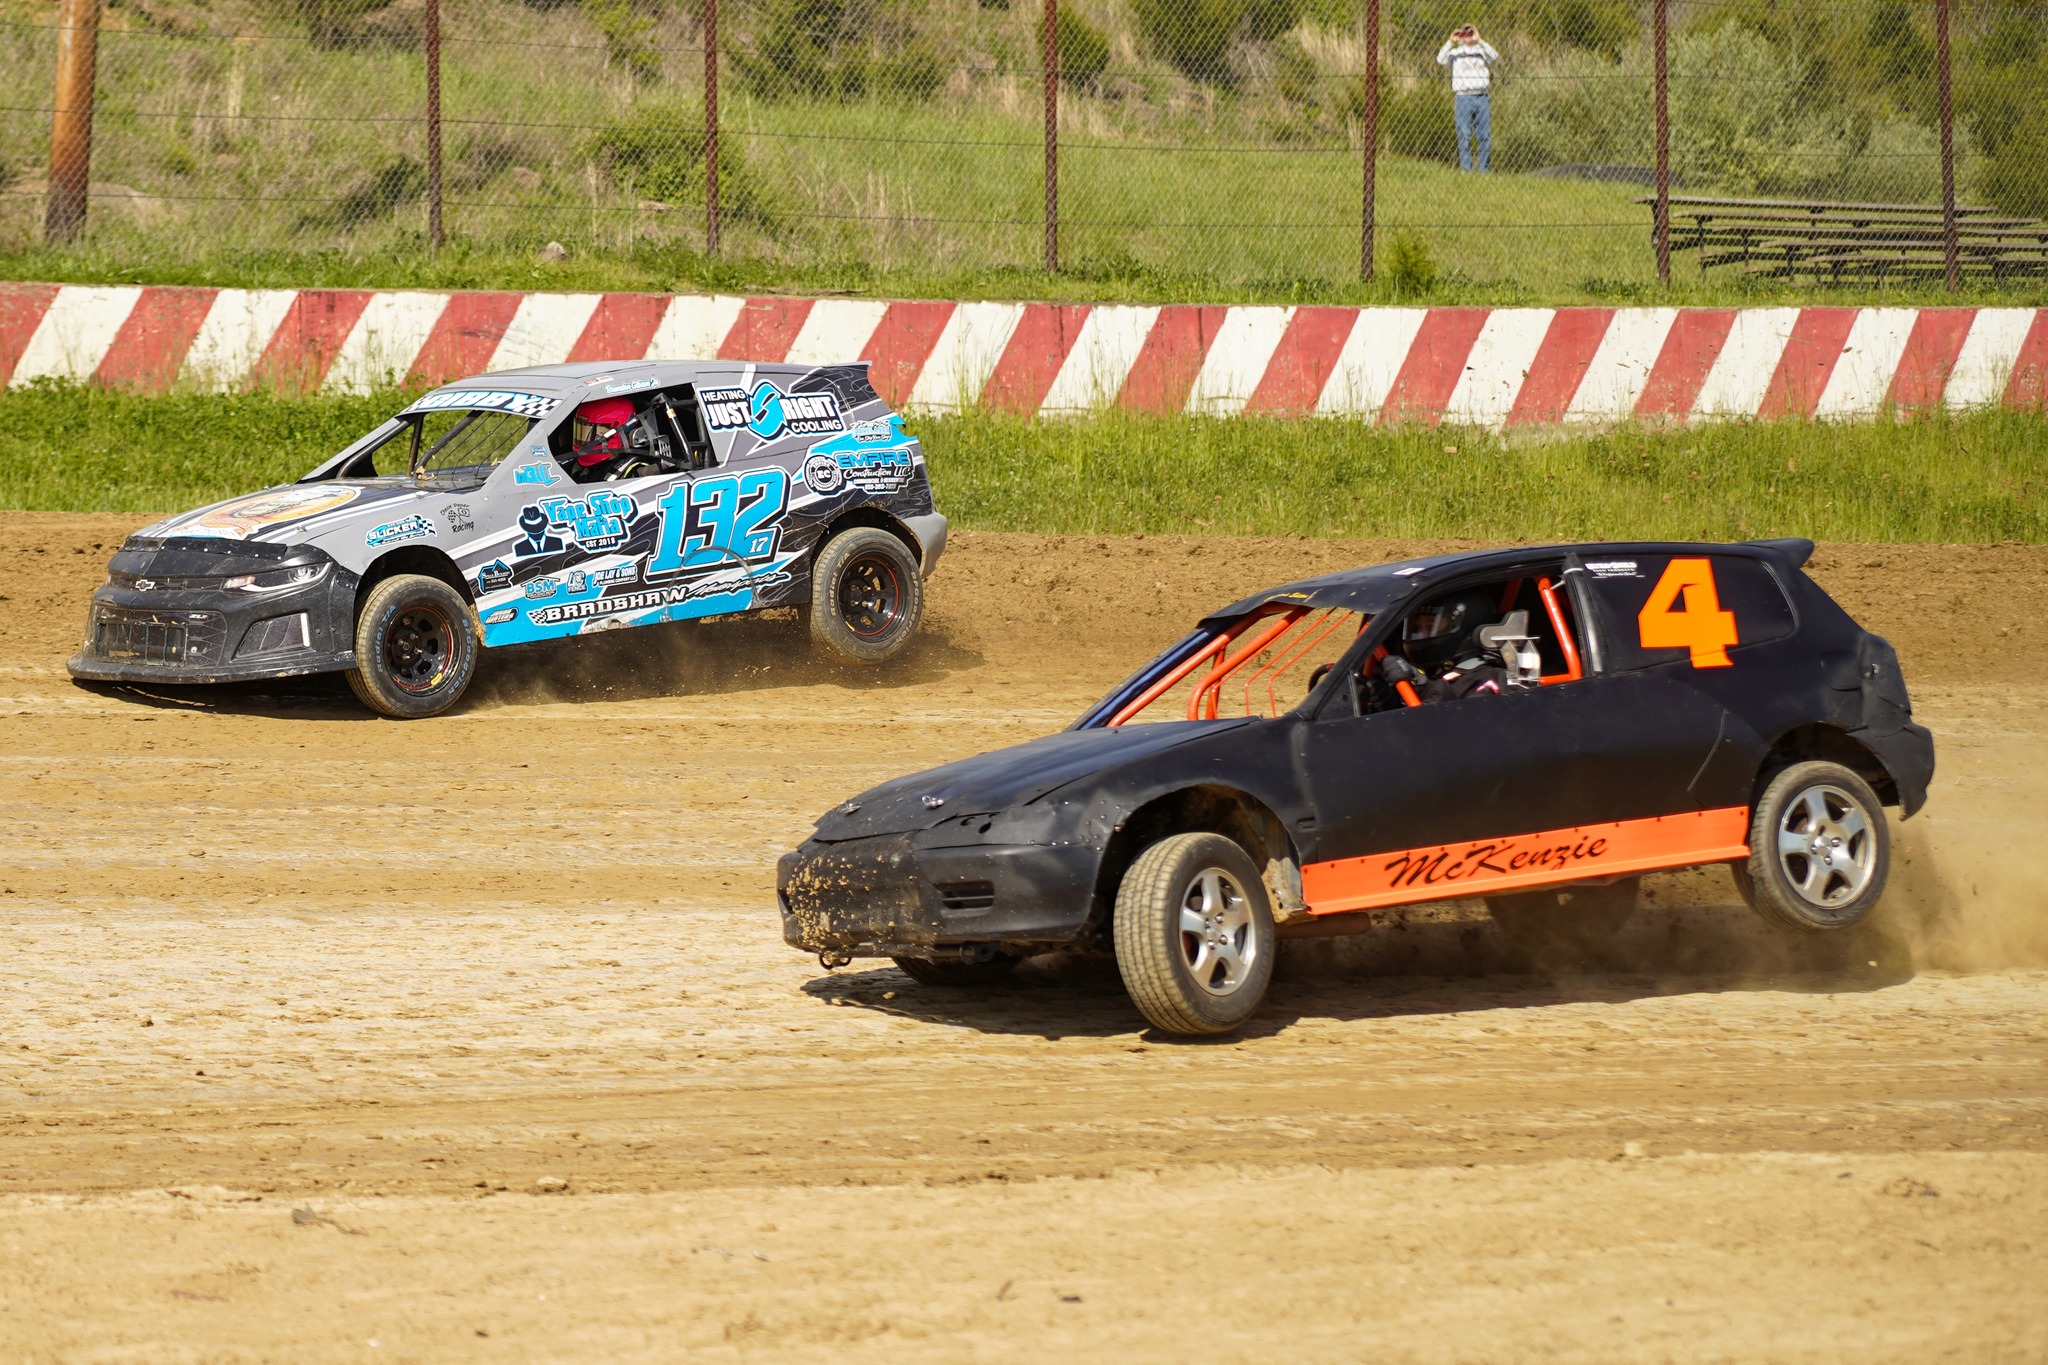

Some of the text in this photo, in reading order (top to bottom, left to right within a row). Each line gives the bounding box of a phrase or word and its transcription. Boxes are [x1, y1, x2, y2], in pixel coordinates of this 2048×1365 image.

[702, 390, 746, 402] HEATING
[706, 396, 836, 427] JUST RIGHT
[791, 419, 842, 433] COOLING
[836, 451, 910, 468] EMPIRE
[816, 469, 831, 479] EC
[843, 467, 892, 479] Construction
[542, 494, 632, 525] Vape Shop
[368, 521, 418, 540] SLICKER
[451, 521, 475, 533] Racing
[574, 515, 622, 539] Mafia
[648, 470, 784, 573] 132
[585, 539, 598, 548] EST
[749, 536, 769, 554] 17
[593, 566, 636, 586] JOE LAY & SONS
[526, 579, 555, 595] BSM
[544, 588, 687, 621] BRADSHAW
[1638, 557, 1739, 668] 4
[1384, 835, 1608, 887] McKenzie
